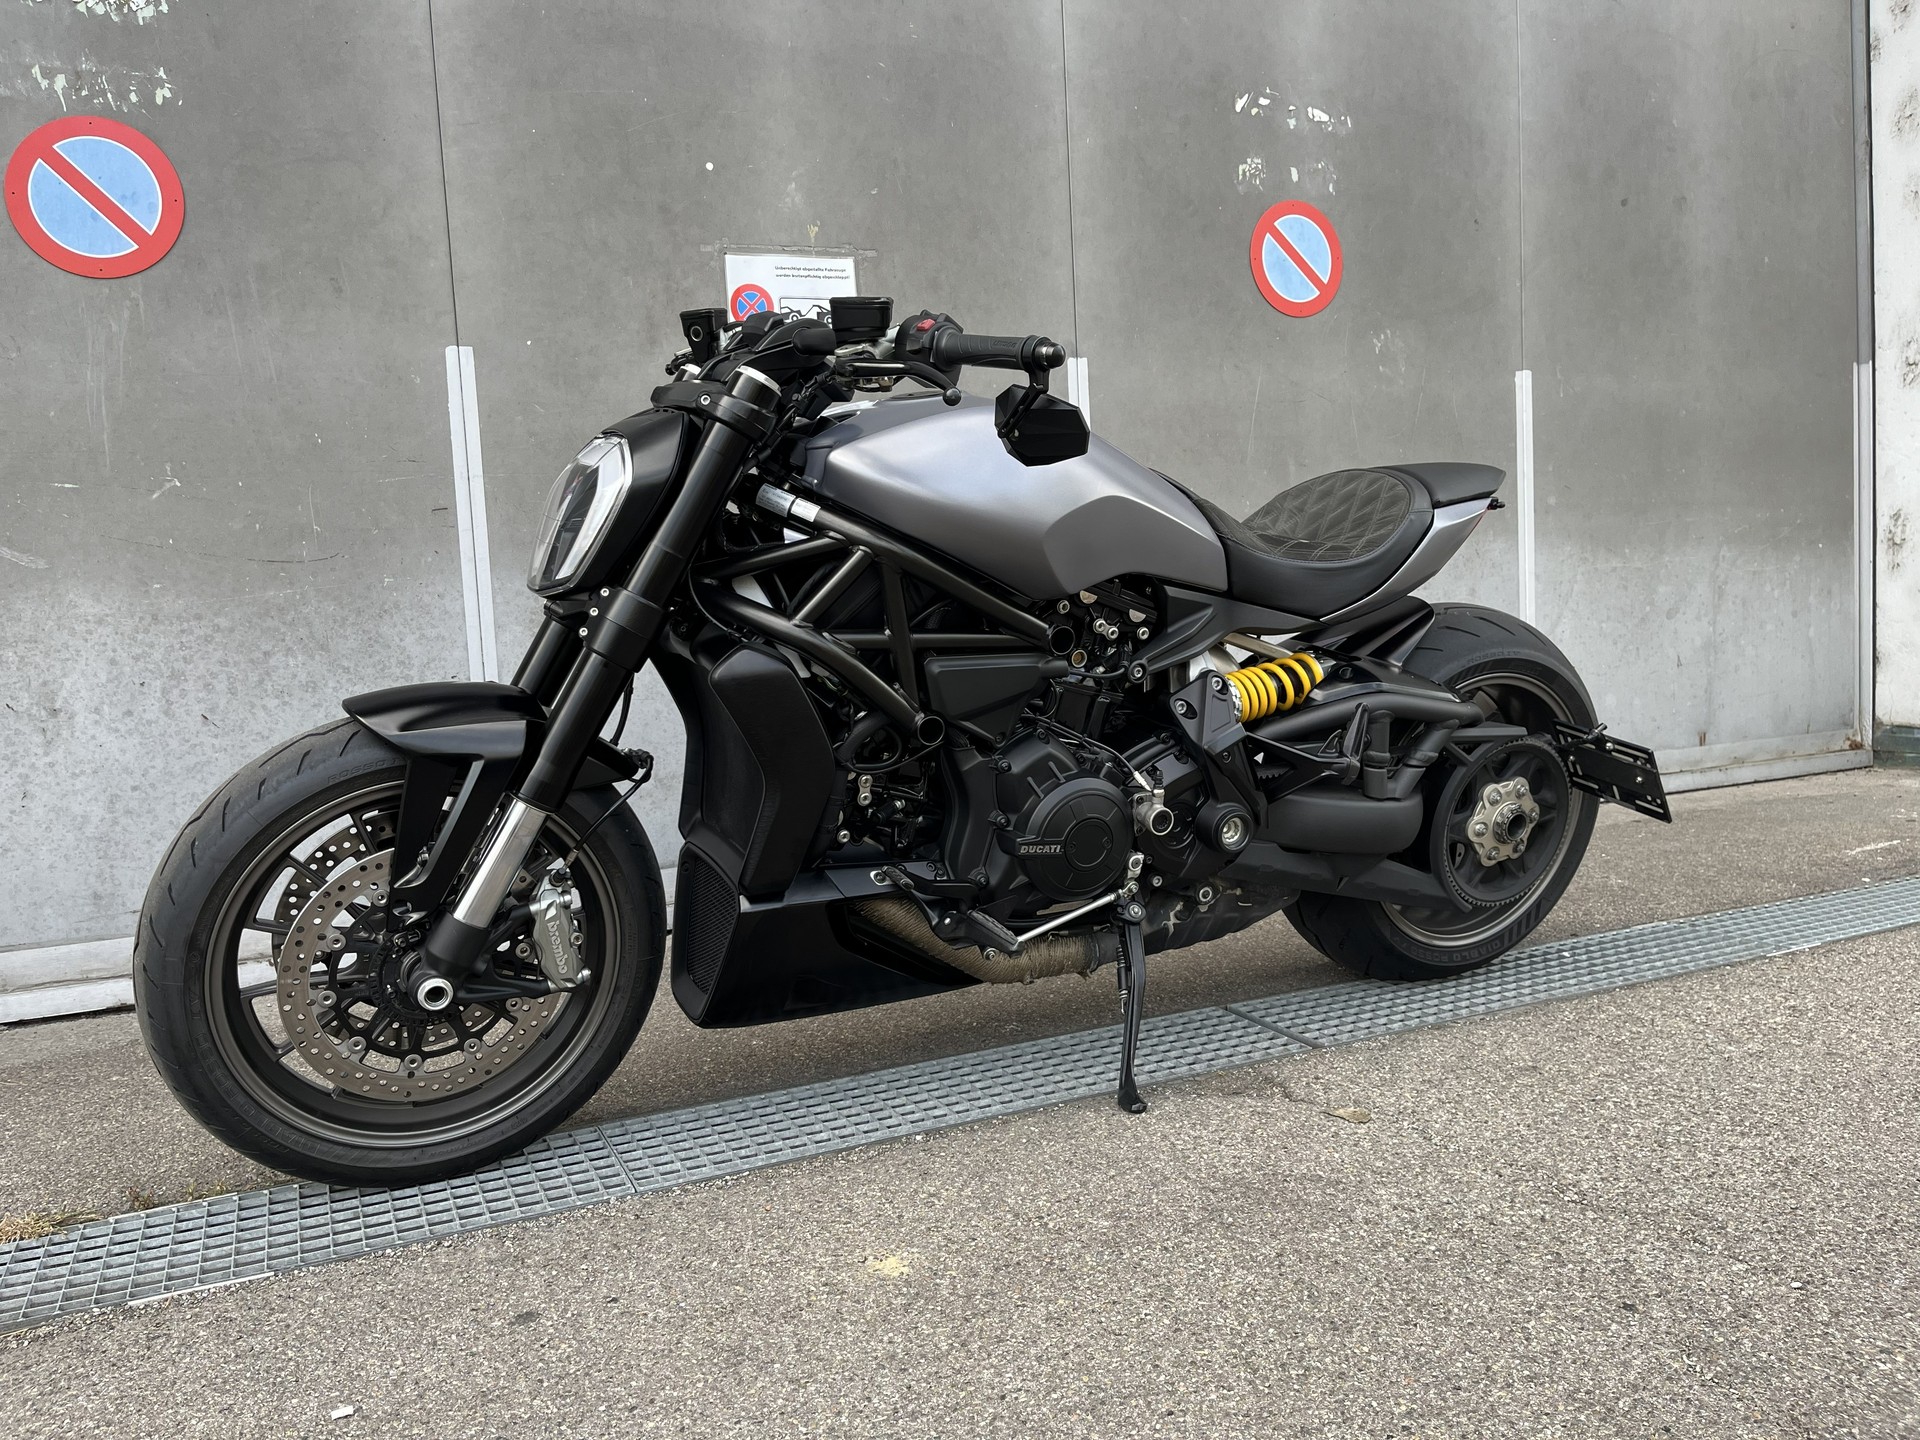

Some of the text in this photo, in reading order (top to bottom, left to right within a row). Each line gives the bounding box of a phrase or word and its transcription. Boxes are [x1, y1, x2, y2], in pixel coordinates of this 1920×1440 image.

[1020, 845, 1061, 853] DUCATI
[546, 919, 568, 974] brembo
[1451, 940, 1501, 961] DIABLO
